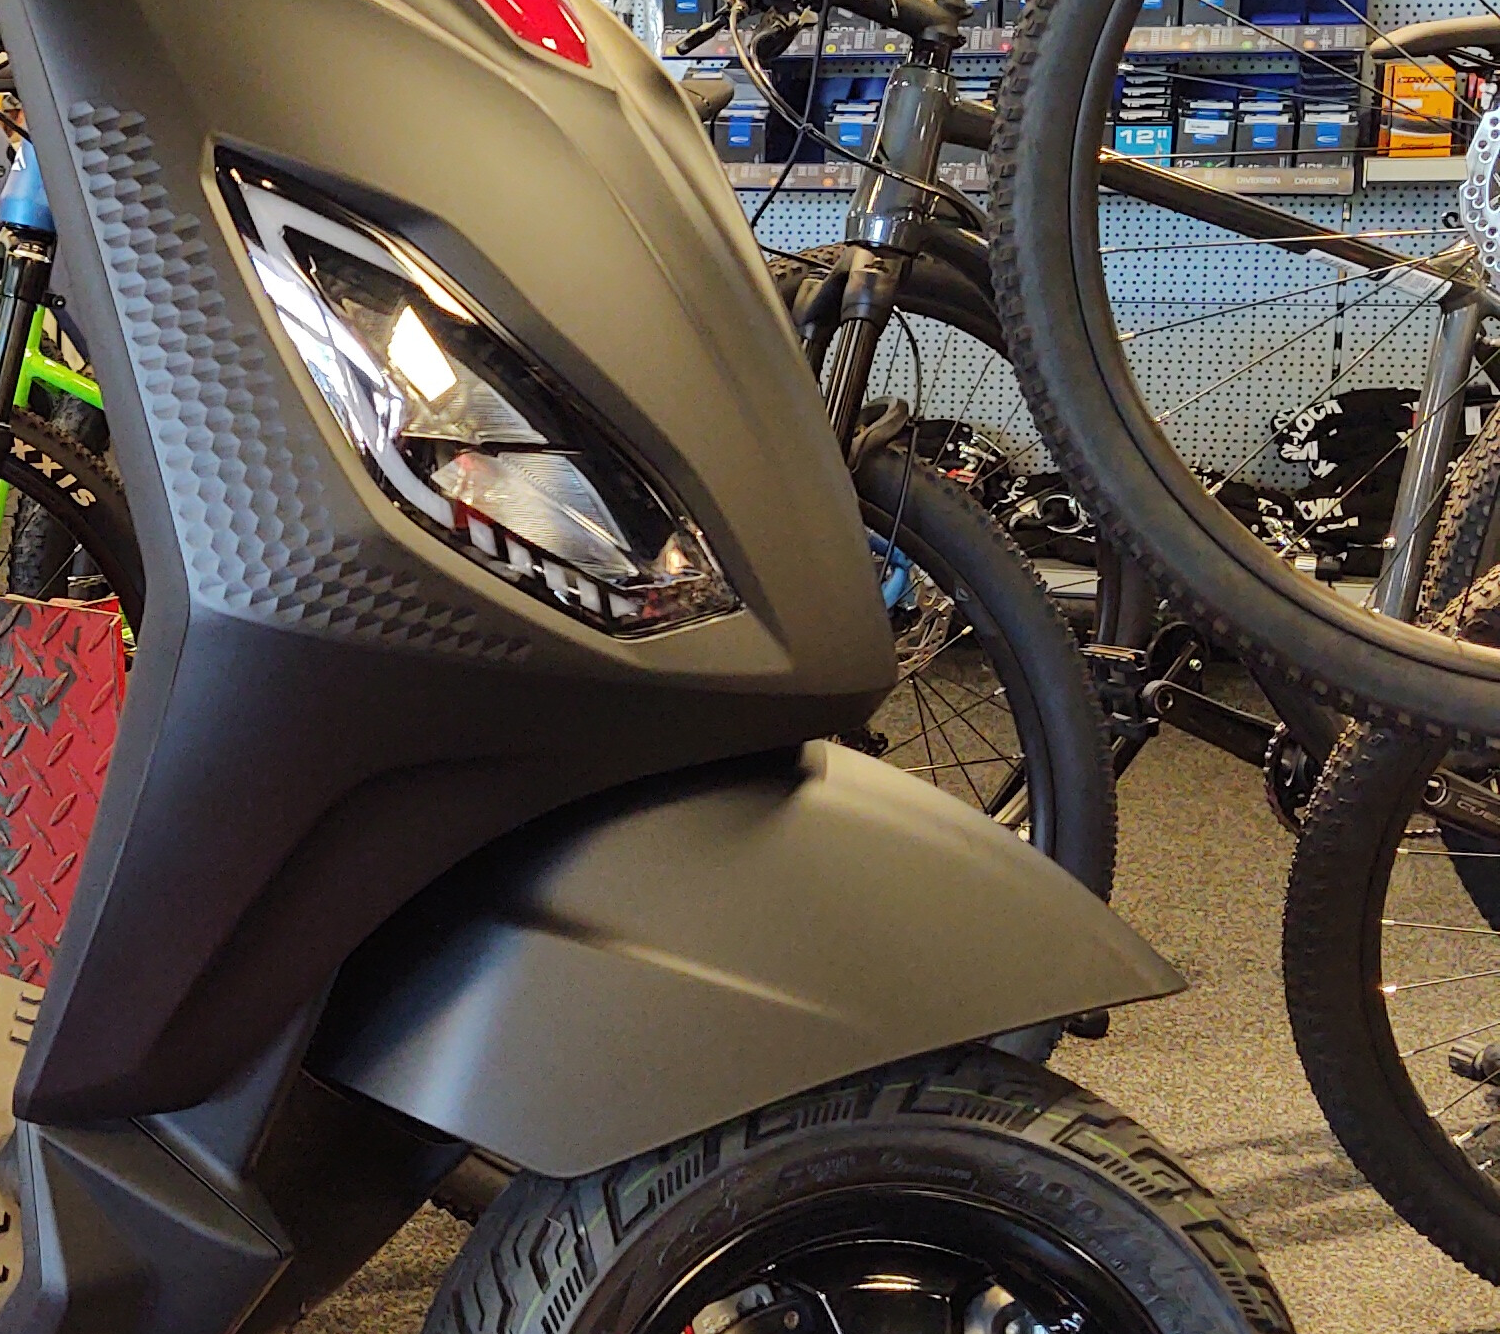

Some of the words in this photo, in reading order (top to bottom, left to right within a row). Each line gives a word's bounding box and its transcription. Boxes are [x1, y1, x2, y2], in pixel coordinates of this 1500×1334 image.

[1119, 129, 1168, 144] 12"
[1236, 176, 1281, 185] DIVERSEN
[1294, 176, 1339, 185] DIVERSEN
